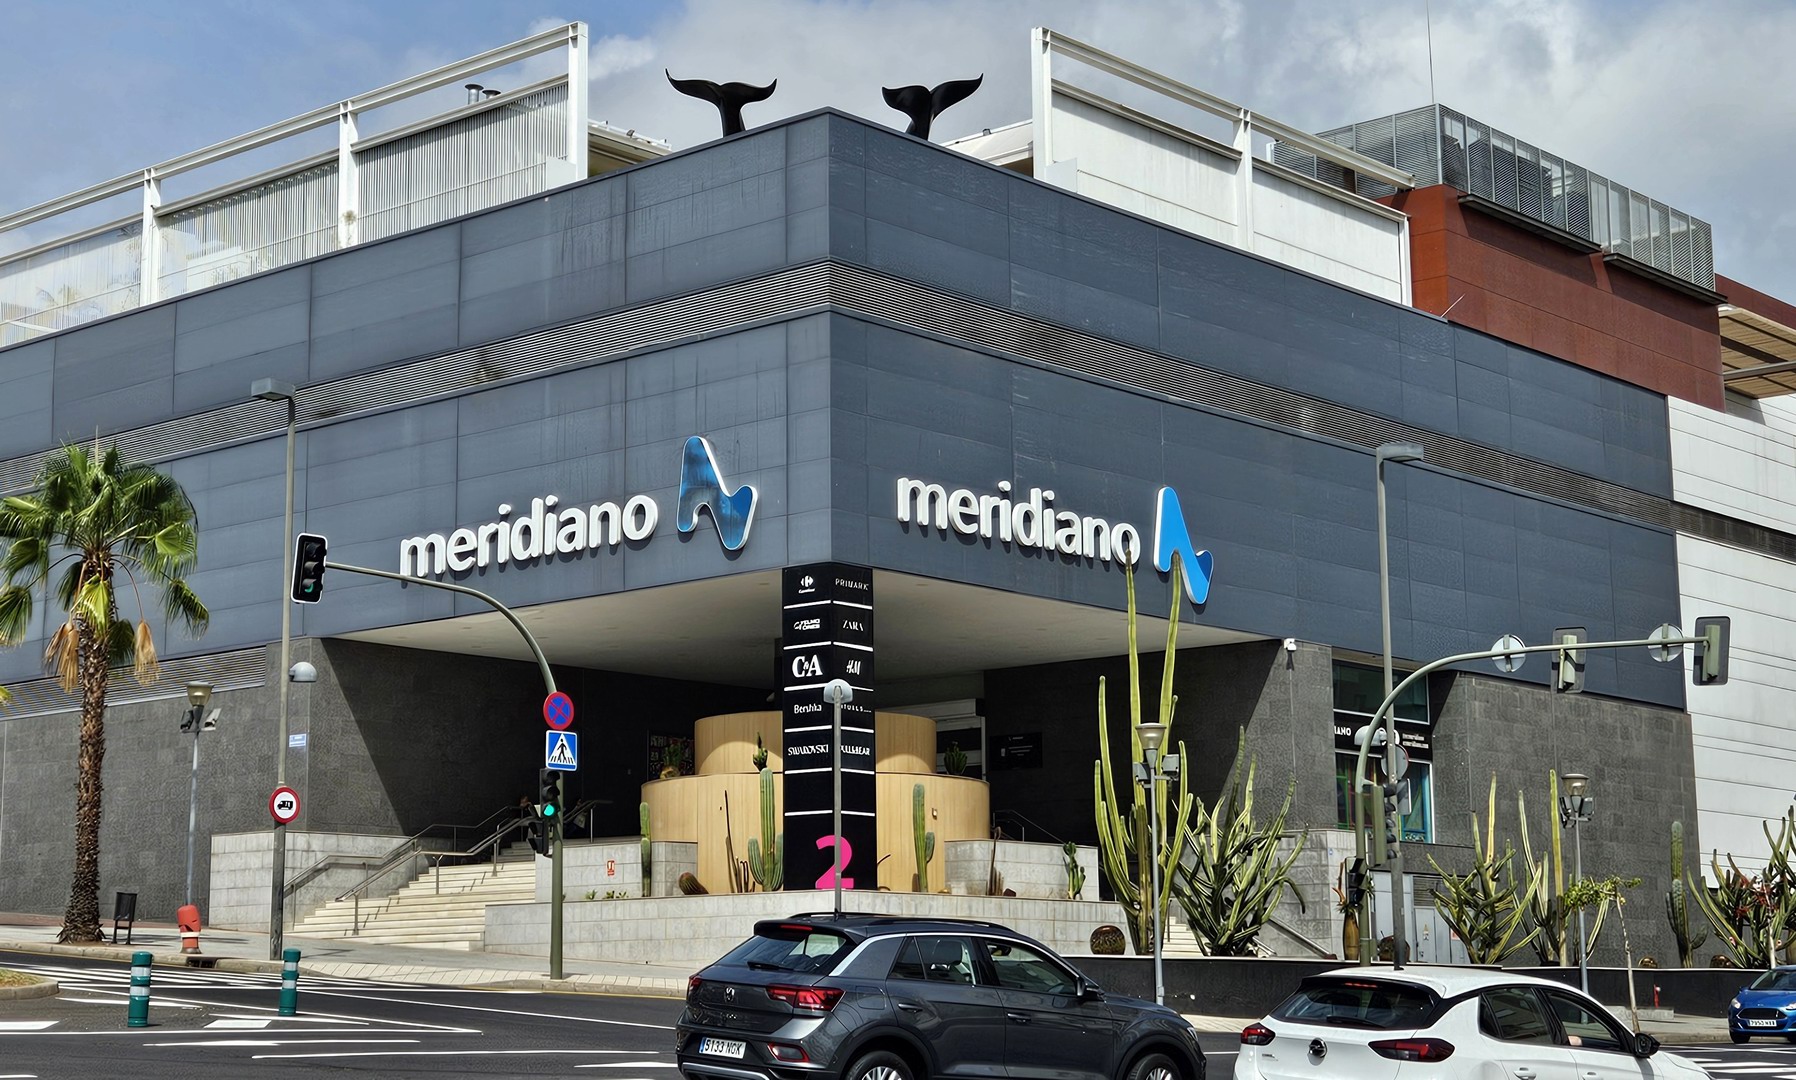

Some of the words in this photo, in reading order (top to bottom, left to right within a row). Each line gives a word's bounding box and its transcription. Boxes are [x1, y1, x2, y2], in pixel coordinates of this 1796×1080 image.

[399, 494, 659, 577] meridiano
[897, 477, 1141, 566] meridiano
[835, 578, 869, 591] PRIMARK
[791, 654, 823, 678] C&A
[815, 834, 854, 890] 2
